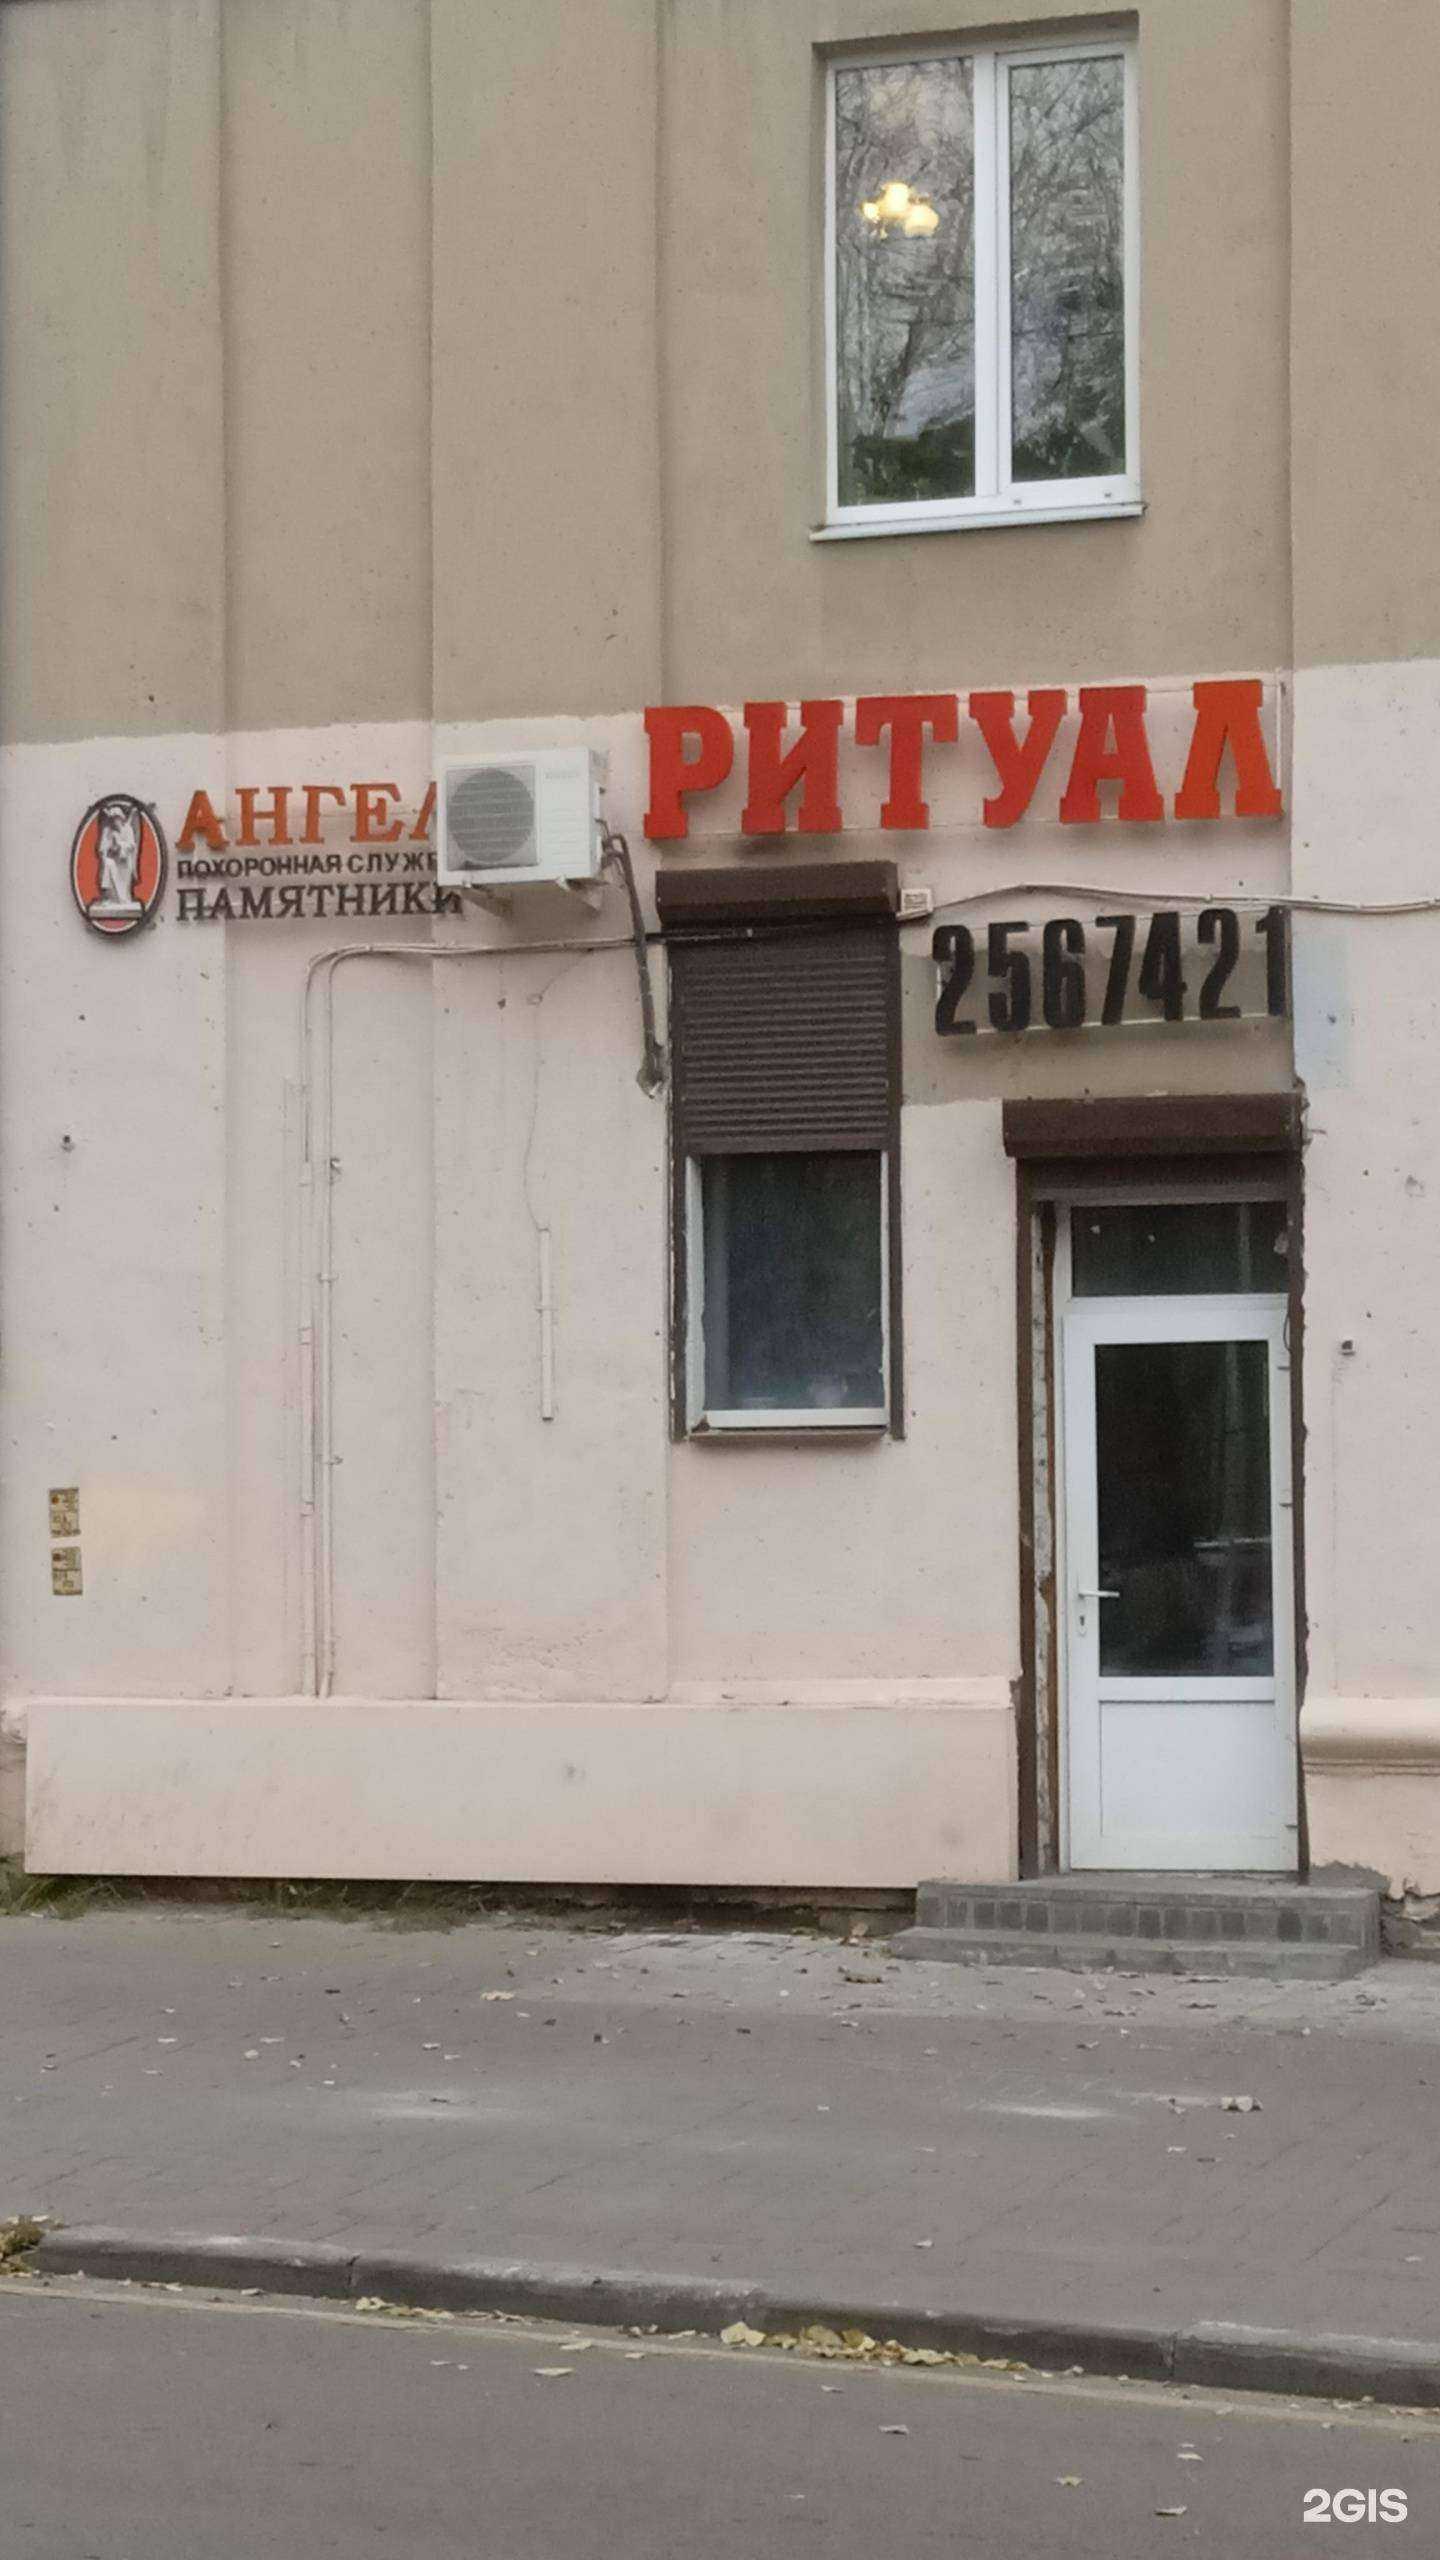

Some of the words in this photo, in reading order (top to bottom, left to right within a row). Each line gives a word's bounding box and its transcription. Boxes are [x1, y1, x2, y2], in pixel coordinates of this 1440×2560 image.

[644, 679, 1283, 838] РИТУАЛ
[176, 882, 463, 921] ПАМЯТНИКИ
[177, 855, 341, 878] ПОХОРОННАЯ
[347, 851, 438, 874] СЛУЖБ
[932, 905, 1289, 1036] 2567421
